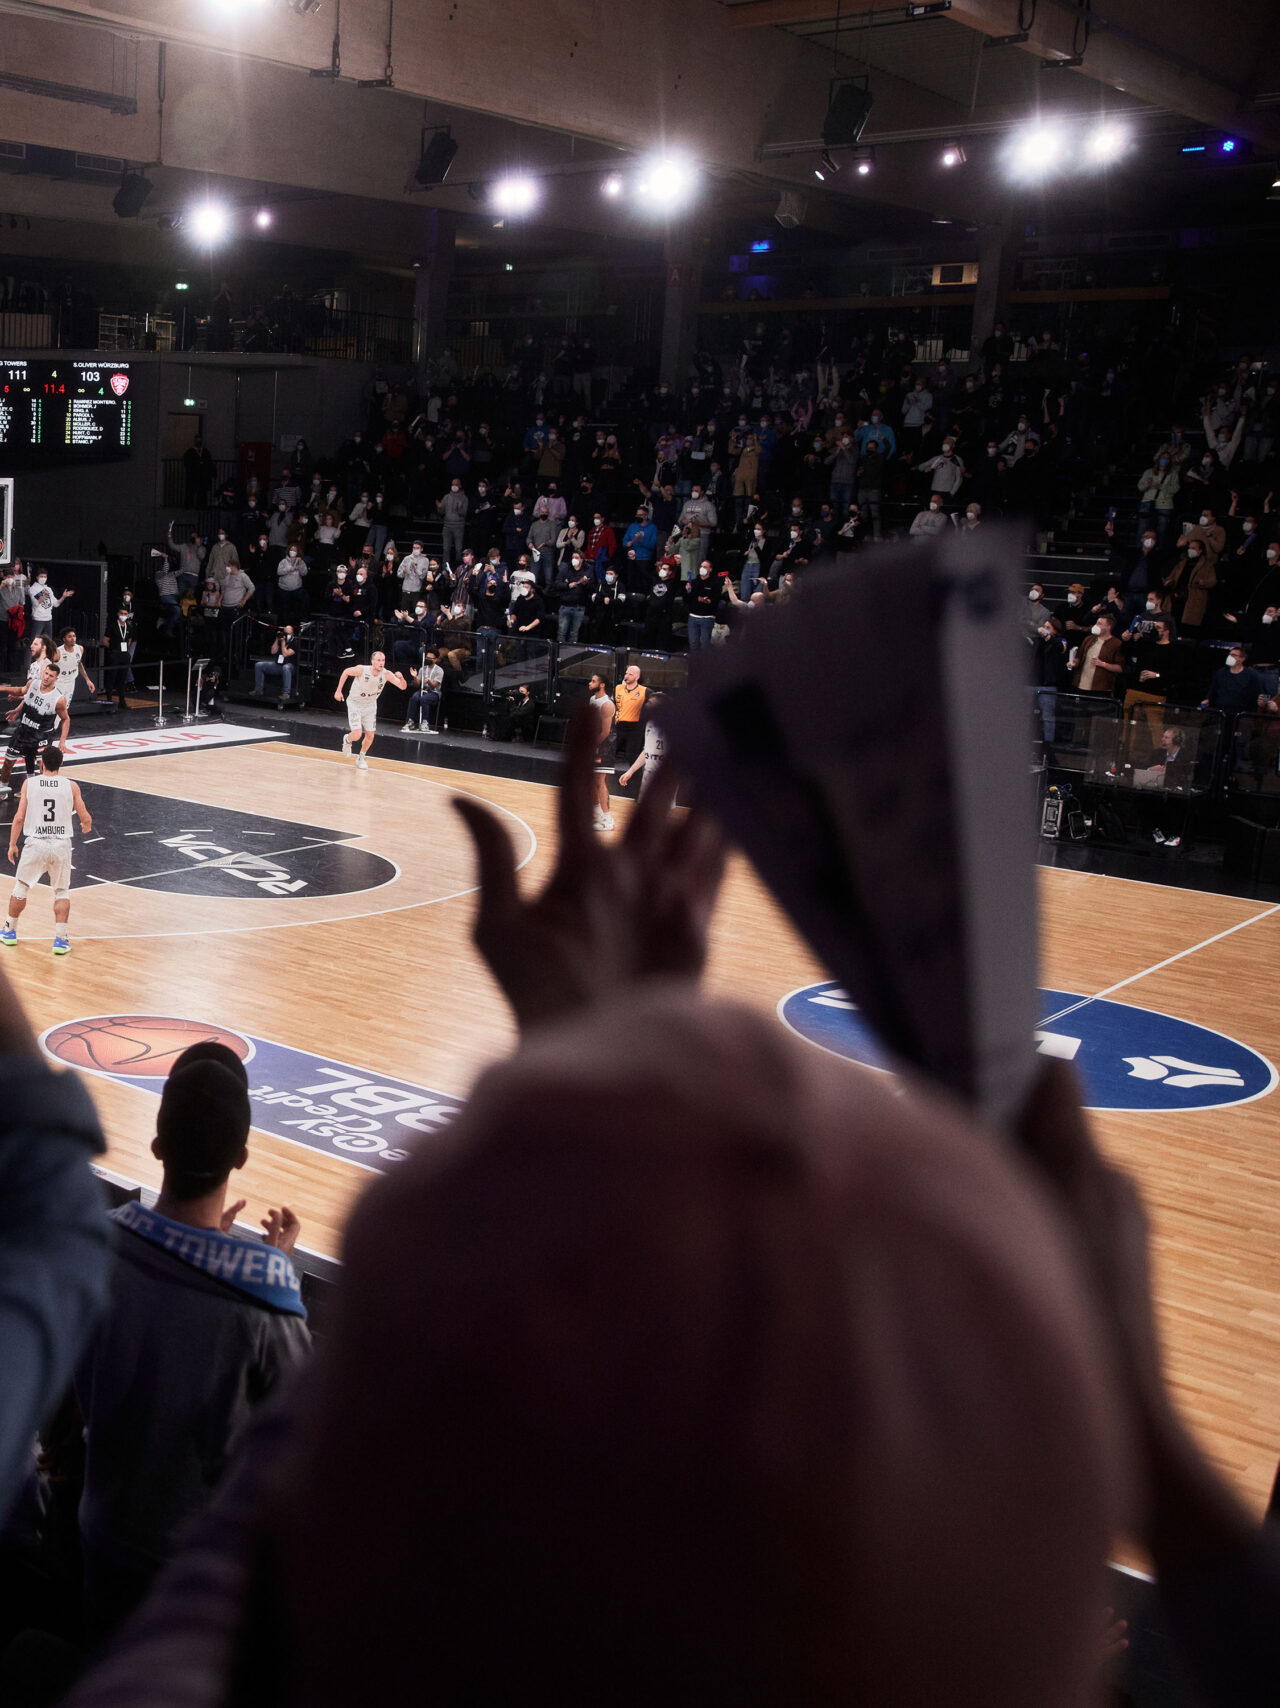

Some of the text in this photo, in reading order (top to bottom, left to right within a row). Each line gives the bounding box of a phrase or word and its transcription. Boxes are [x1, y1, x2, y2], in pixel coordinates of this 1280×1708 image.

[8, 370, 26, 380] 111
[51, 370, 58, 378] 4
[80, 372, 100, 382] 103
[44, 384, 65, 394] 11.4
[34, 696, 44, 707] 65
[40, 780, 58, 788] DILEO
[43, 798, 56, 822] 3
[247, 1085, 383, 1132] Credit
